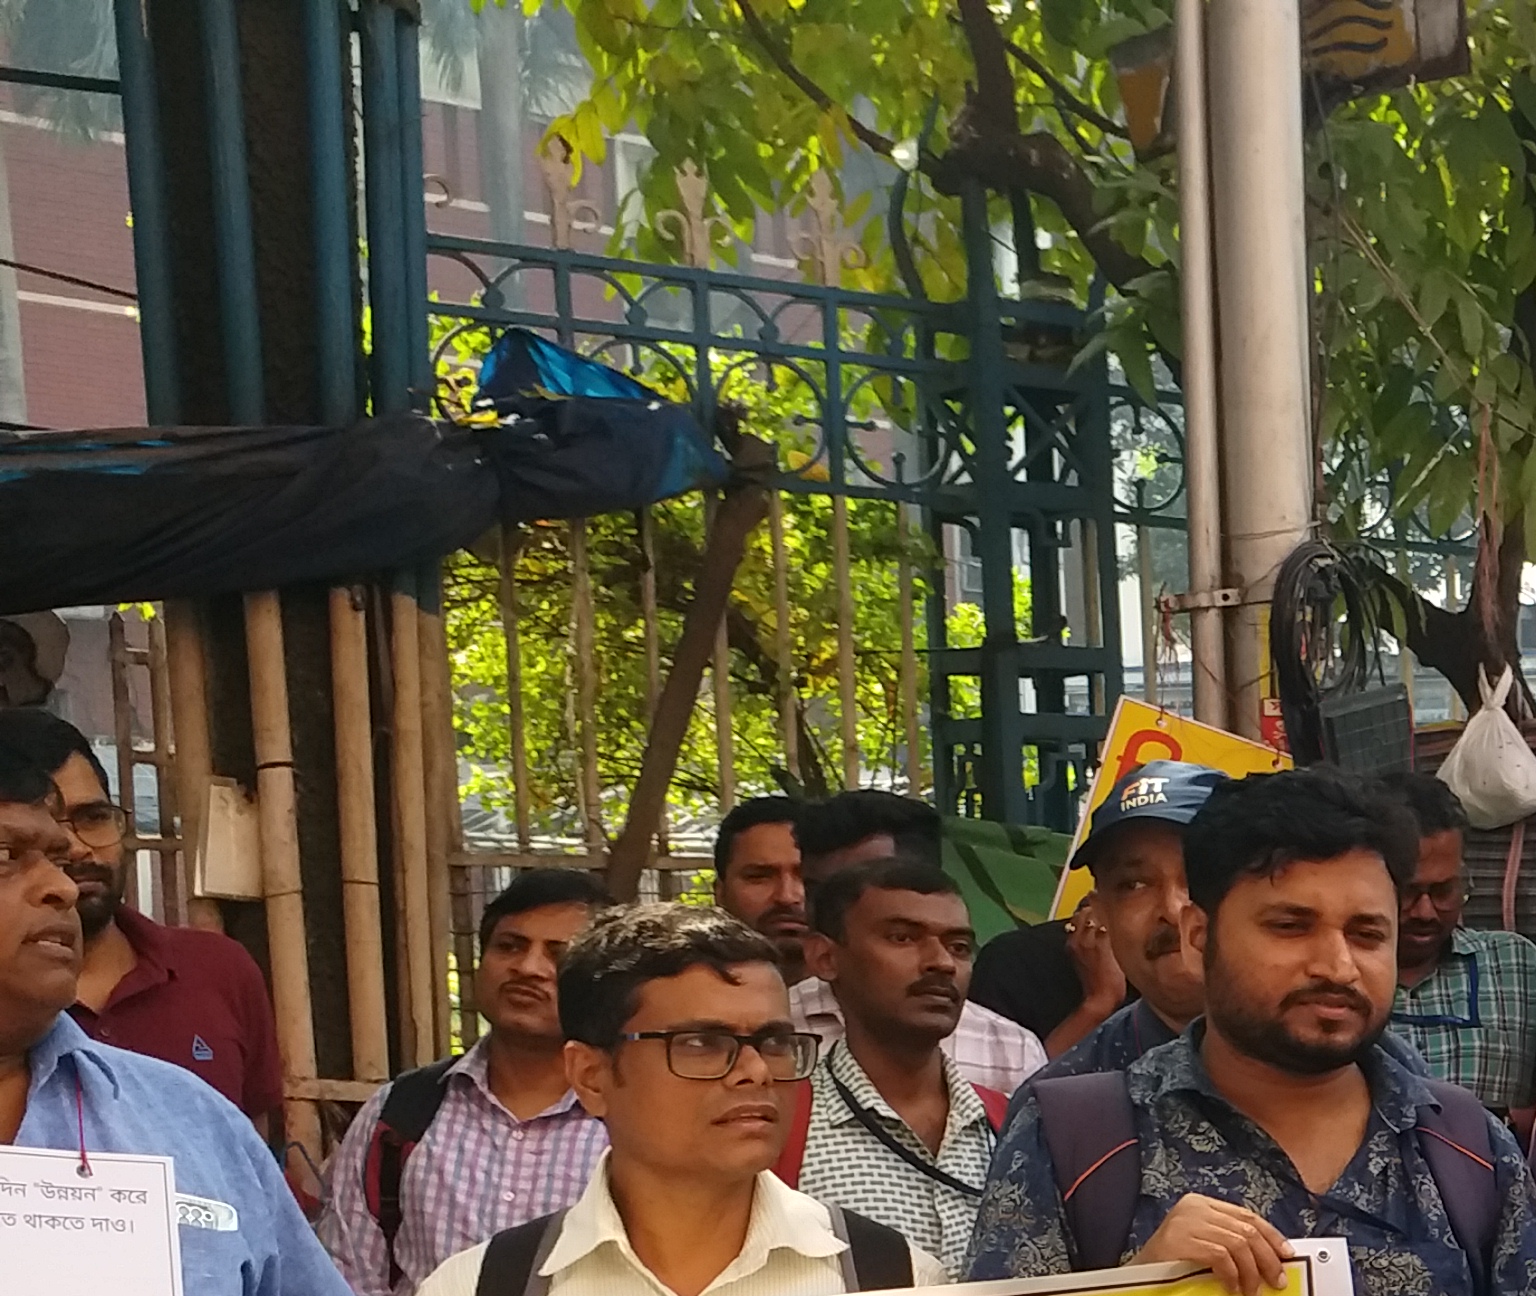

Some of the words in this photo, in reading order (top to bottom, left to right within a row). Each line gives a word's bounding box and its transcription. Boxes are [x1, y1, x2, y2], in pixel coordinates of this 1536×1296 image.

[1120, 792, 1168, 812] INDIA
[108, 1188, 149, 1205] করে
[23, 1213, 86, 1231] থাকতে
